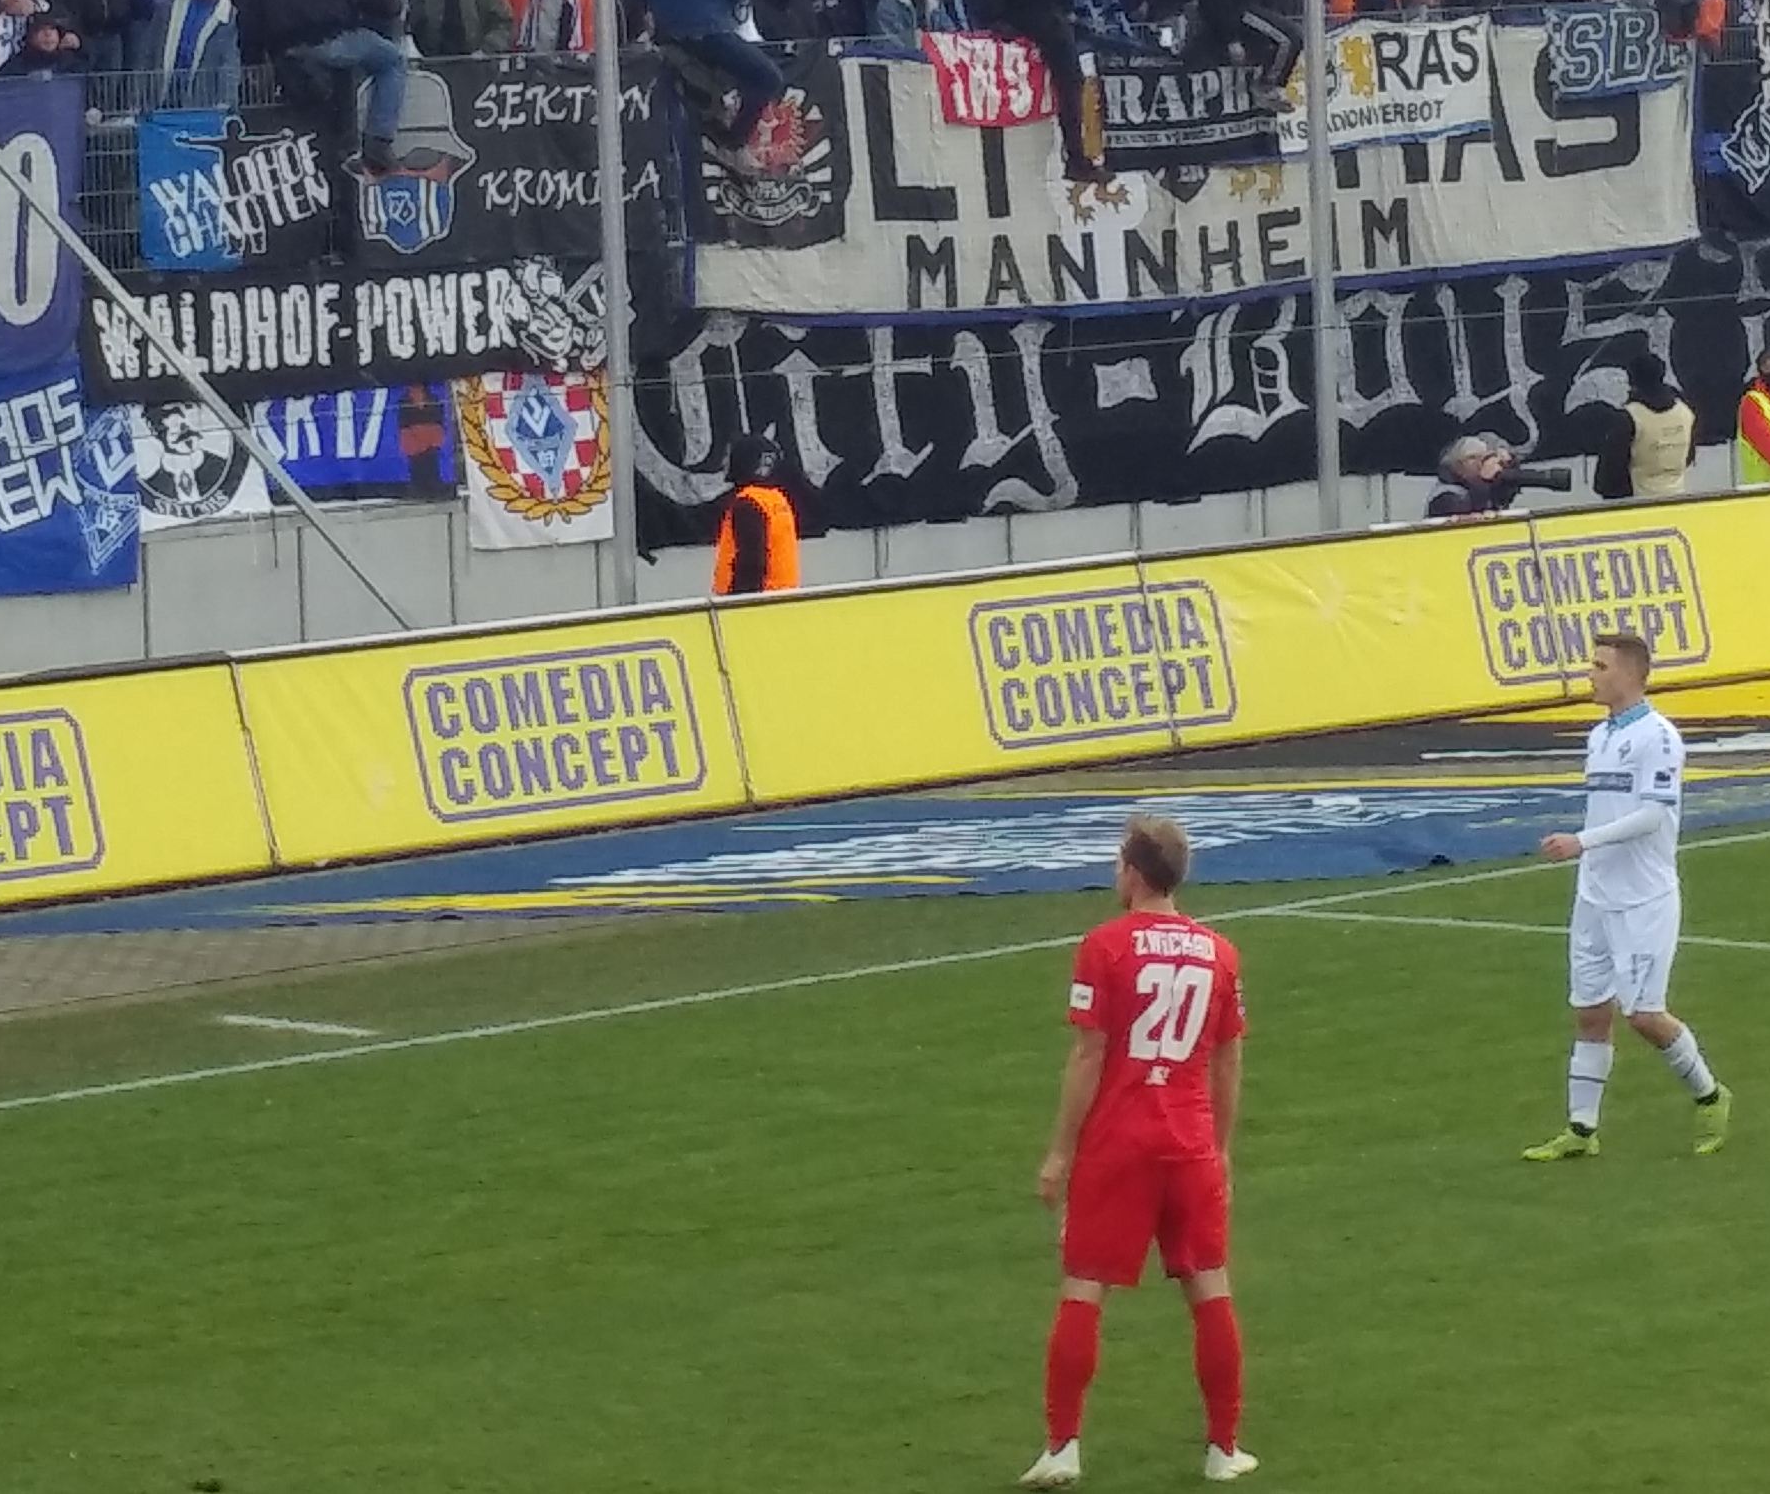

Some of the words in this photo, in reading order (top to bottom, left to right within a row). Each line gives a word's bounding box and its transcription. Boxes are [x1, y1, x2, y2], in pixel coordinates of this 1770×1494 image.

[149, 131, 320, 217] WALDHOF
[90, 266, 516, 381] WALDHOF-POWER
[1484, 544, 1684, 613] COMEDIA
[988, 592, 1208, 672] COMEDIA
[425, 656, 674, 739] COMEDIA
[1000, 654, 1214, 734] CONCEPT
[438, 720, 682, 806] CONCEPT
[1127, 961, 1215, 1063] 20
